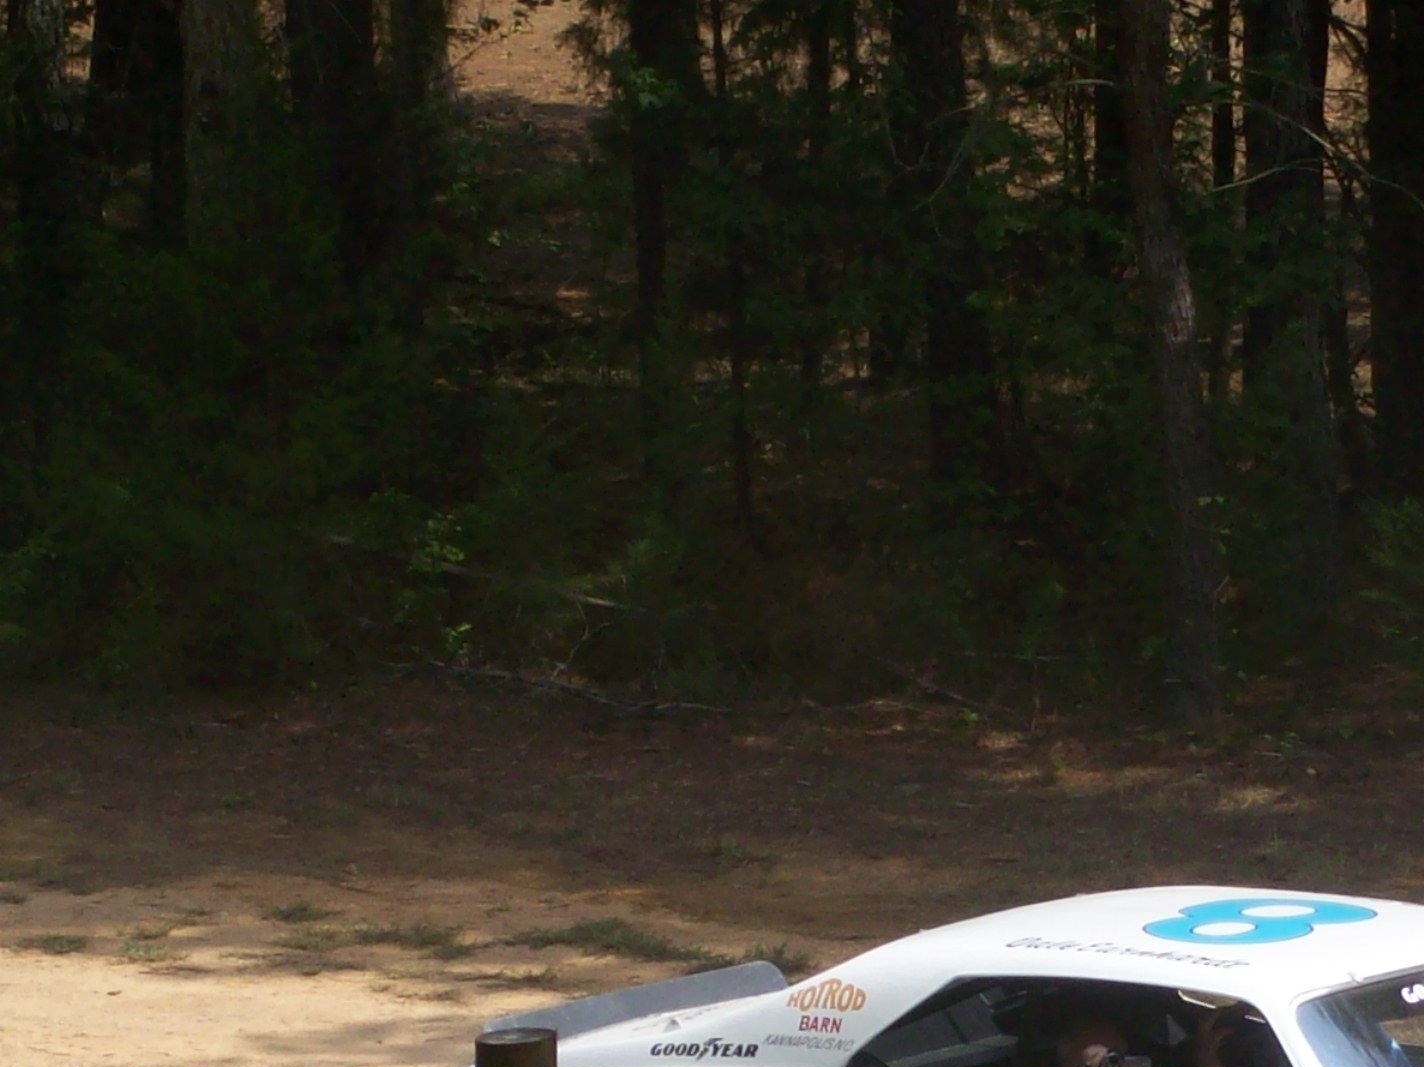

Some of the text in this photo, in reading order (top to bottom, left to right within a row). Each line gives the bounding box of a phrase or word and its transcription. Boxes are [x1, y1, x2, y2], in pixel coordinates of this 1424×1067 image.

[1143, 898, 1378, 944] 8
[798, 1014, 843, 1034] BARN
[650, 1038, 759, 1061] GOODYEAR
